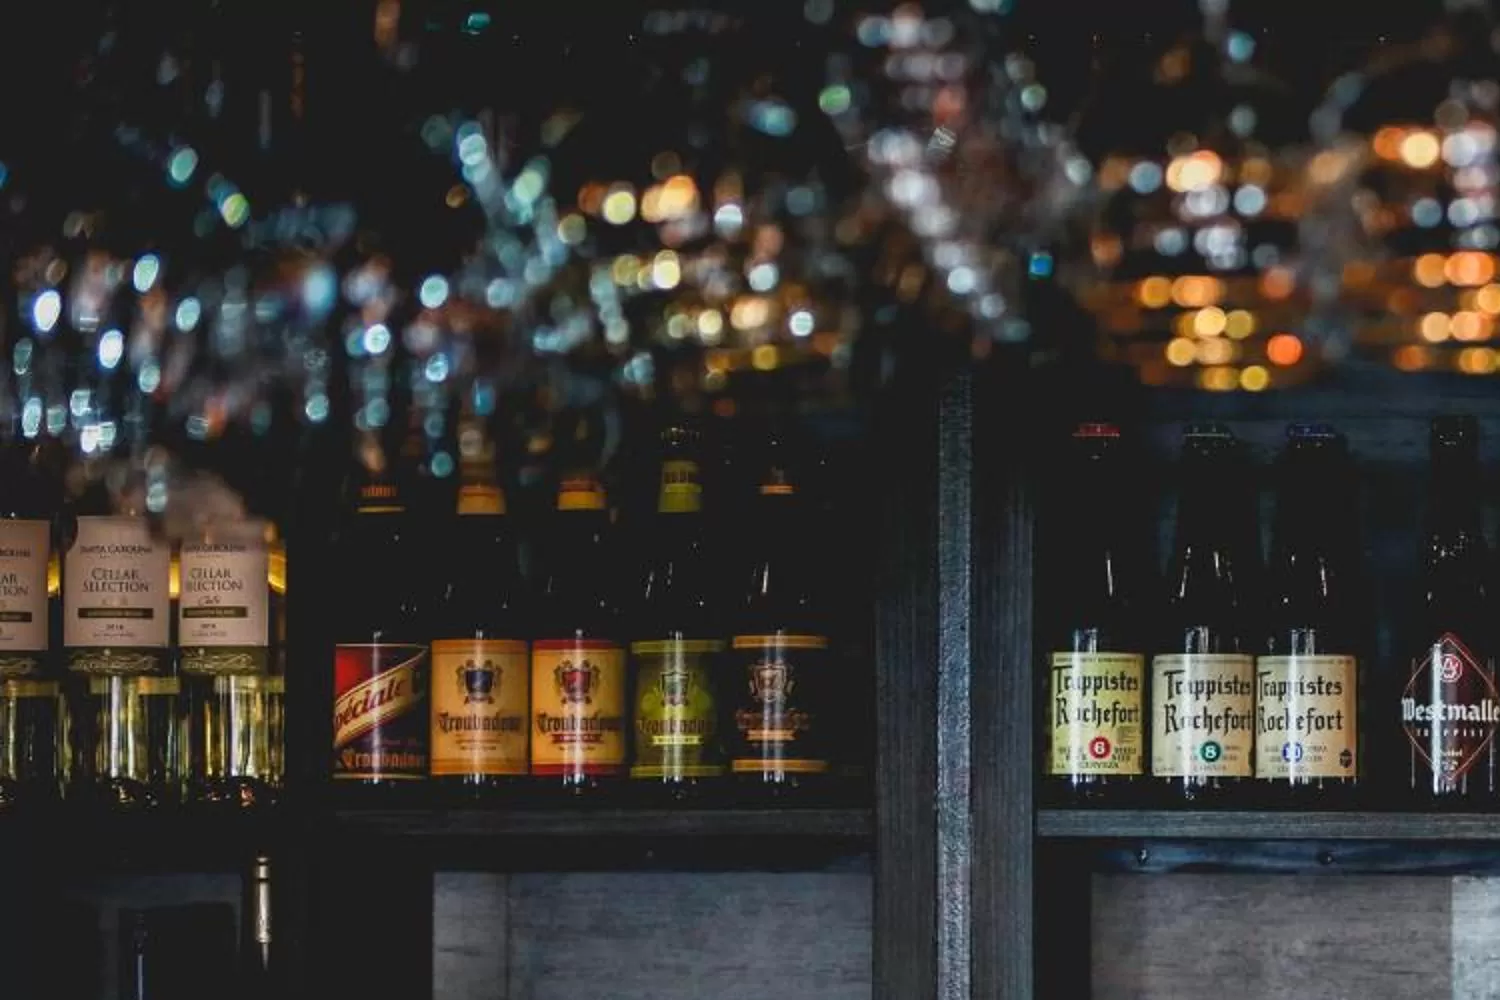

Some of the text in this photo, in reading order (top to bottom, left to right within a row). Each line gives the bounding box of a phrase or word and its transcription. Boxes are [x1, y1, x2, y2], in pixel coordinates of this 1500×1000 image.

[91, 567, 140, 580] CELLAR
[82, 580, 150, 592] SELECTION
[1257, 670, 1343, 702] Trapistes
[1402, 697, 1500, 722] Westmalle
[1205, 745, 1218, 760] 8
